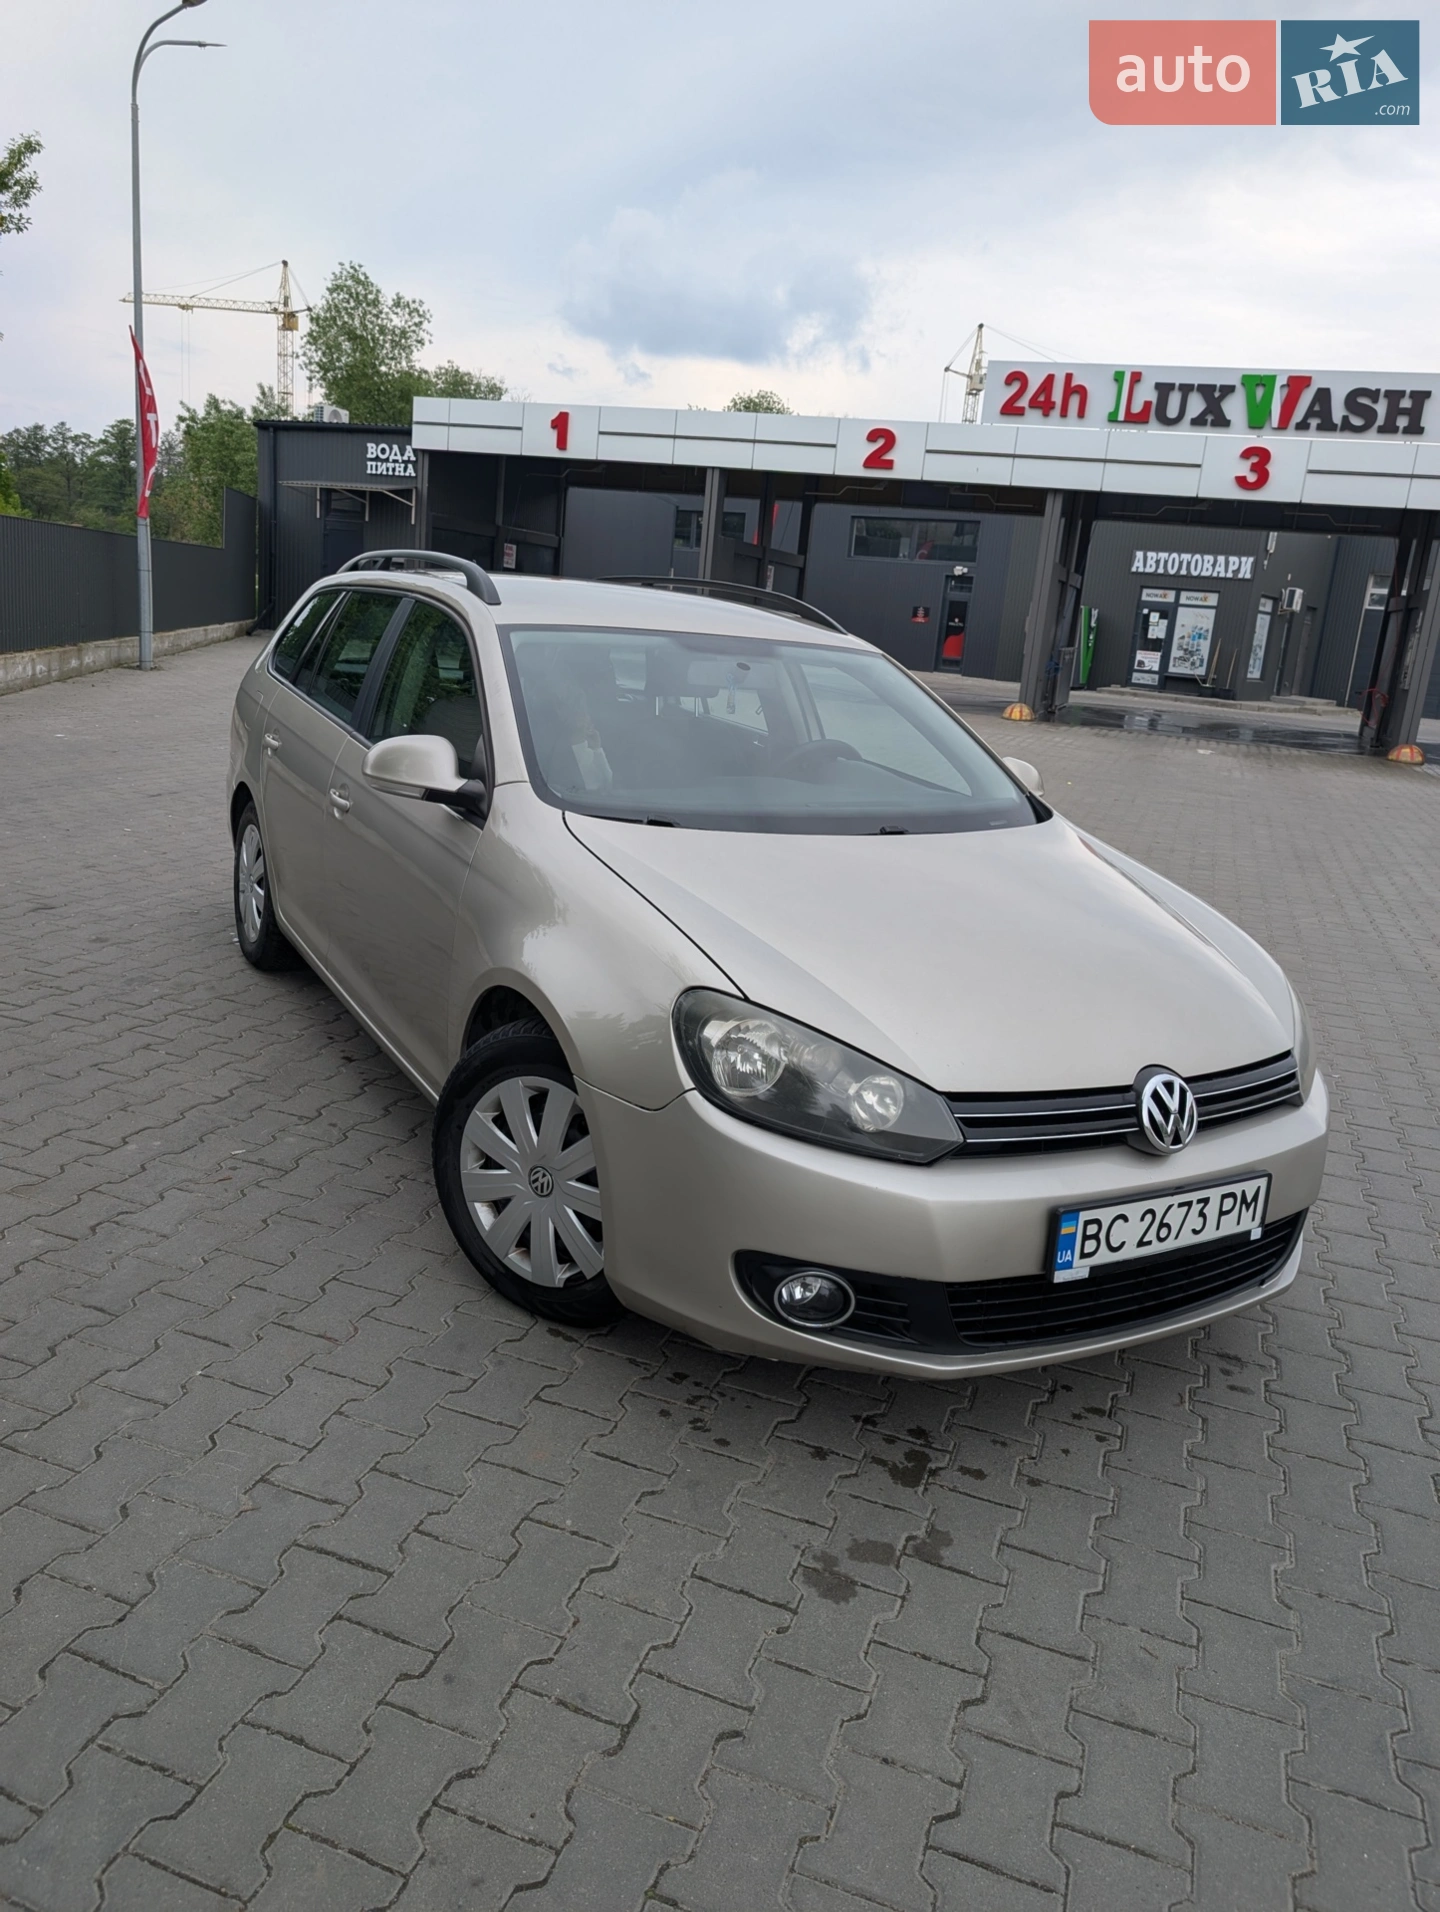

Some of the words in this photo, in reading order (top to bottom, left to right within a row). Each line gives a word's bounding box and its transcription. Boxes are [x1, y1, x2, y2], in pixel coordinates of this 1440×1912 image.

[999, 370, 1088, 419] 24h
[550, 411, 569, 450] 1
[862, 428, 896, 470] 2
[366, 442, 416, 462] ВОДА
[366, 461, 416, 477] ПИТНА
[1234, 446, 1272, 491] 3
[1131, 551, 1254, 578] АВТОТОВАРИ
[1079, 1213, 1129, 1260] BC
[1136, 1196, 1210, 1249] 2673
[1215, 1185, 1262, 1231] PM
[1057, 1249, 1072, 1264] UA
